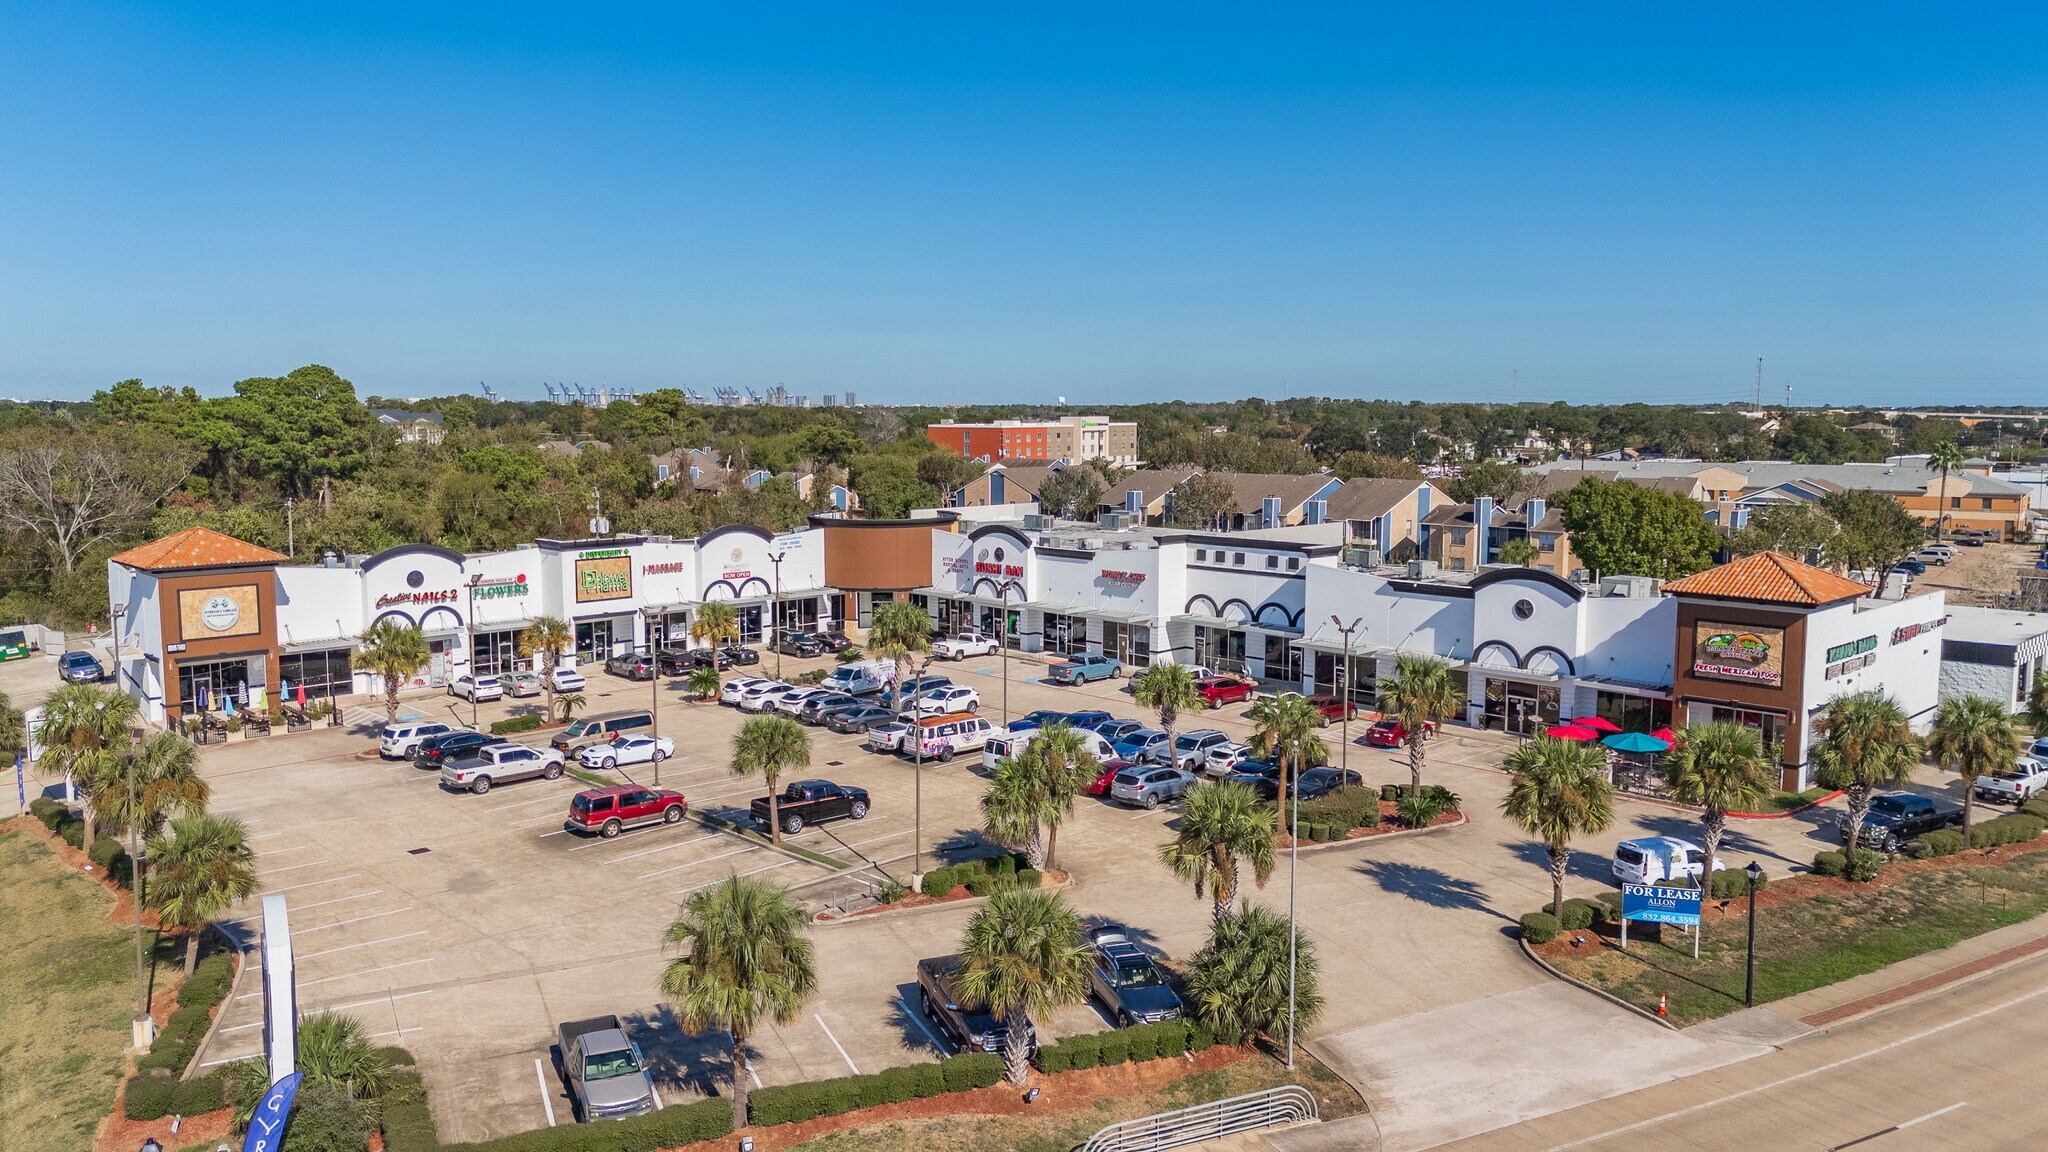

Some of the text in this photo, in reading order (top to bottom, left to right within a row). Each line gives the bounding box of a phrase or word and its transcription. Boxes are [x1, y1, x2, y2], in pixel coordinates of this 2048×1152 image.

[975, 562, 1023, 577] BUSHI BAN
[413, 590, 448, 604] NAILS
[450, 589, 458, 601] 2
[473, 584, 529, 599] FLOWERS
[1694, 663, 1780, 680] FRESH MEXICAN FOOD
[1625, 886, 1699, 900] FOR LEASE
[1642, 913, 1699, 924] 832.864.3594
